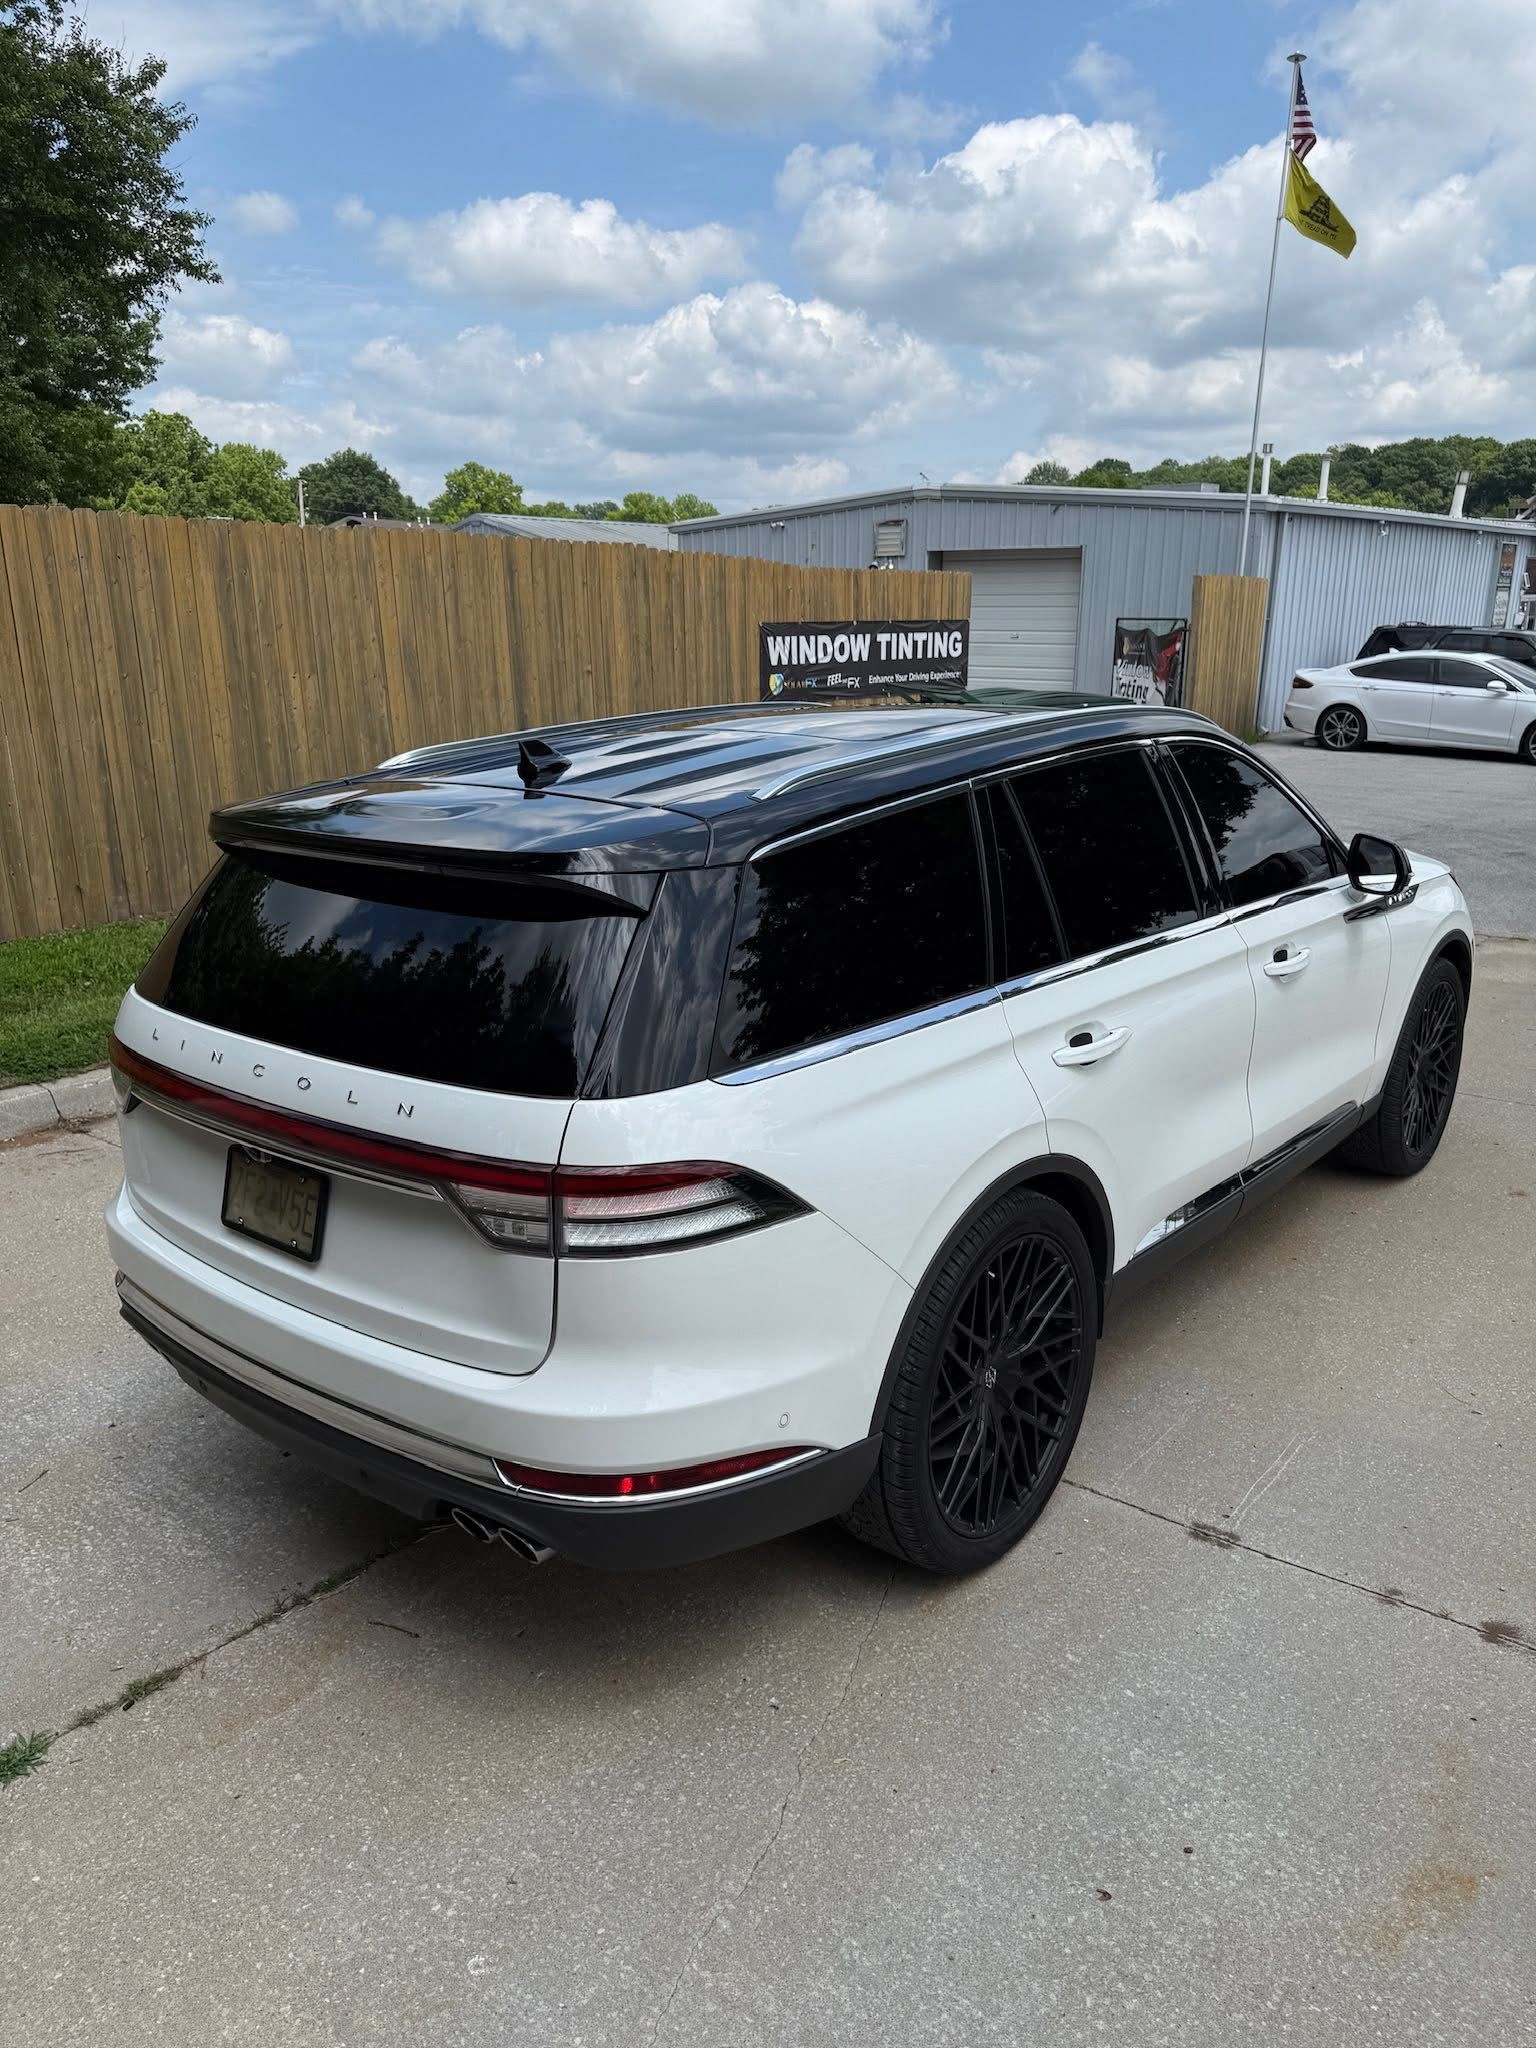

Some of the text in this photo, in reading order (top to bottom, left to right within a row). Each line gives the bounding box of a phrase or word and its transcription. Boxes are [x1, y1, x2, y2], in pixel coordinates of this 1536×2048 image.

[767, 631, 963, 666] WINDOW TINTING
[827, 673, 842, 687] FEEL
[847, 677, 861, 689] FX
[868, 674, 894, 684] Enhance
[895, 673, 909, 682] Your
[908, 672, 930, 683] Driving
[152, 1028, 415, 1118] LINCOLN
